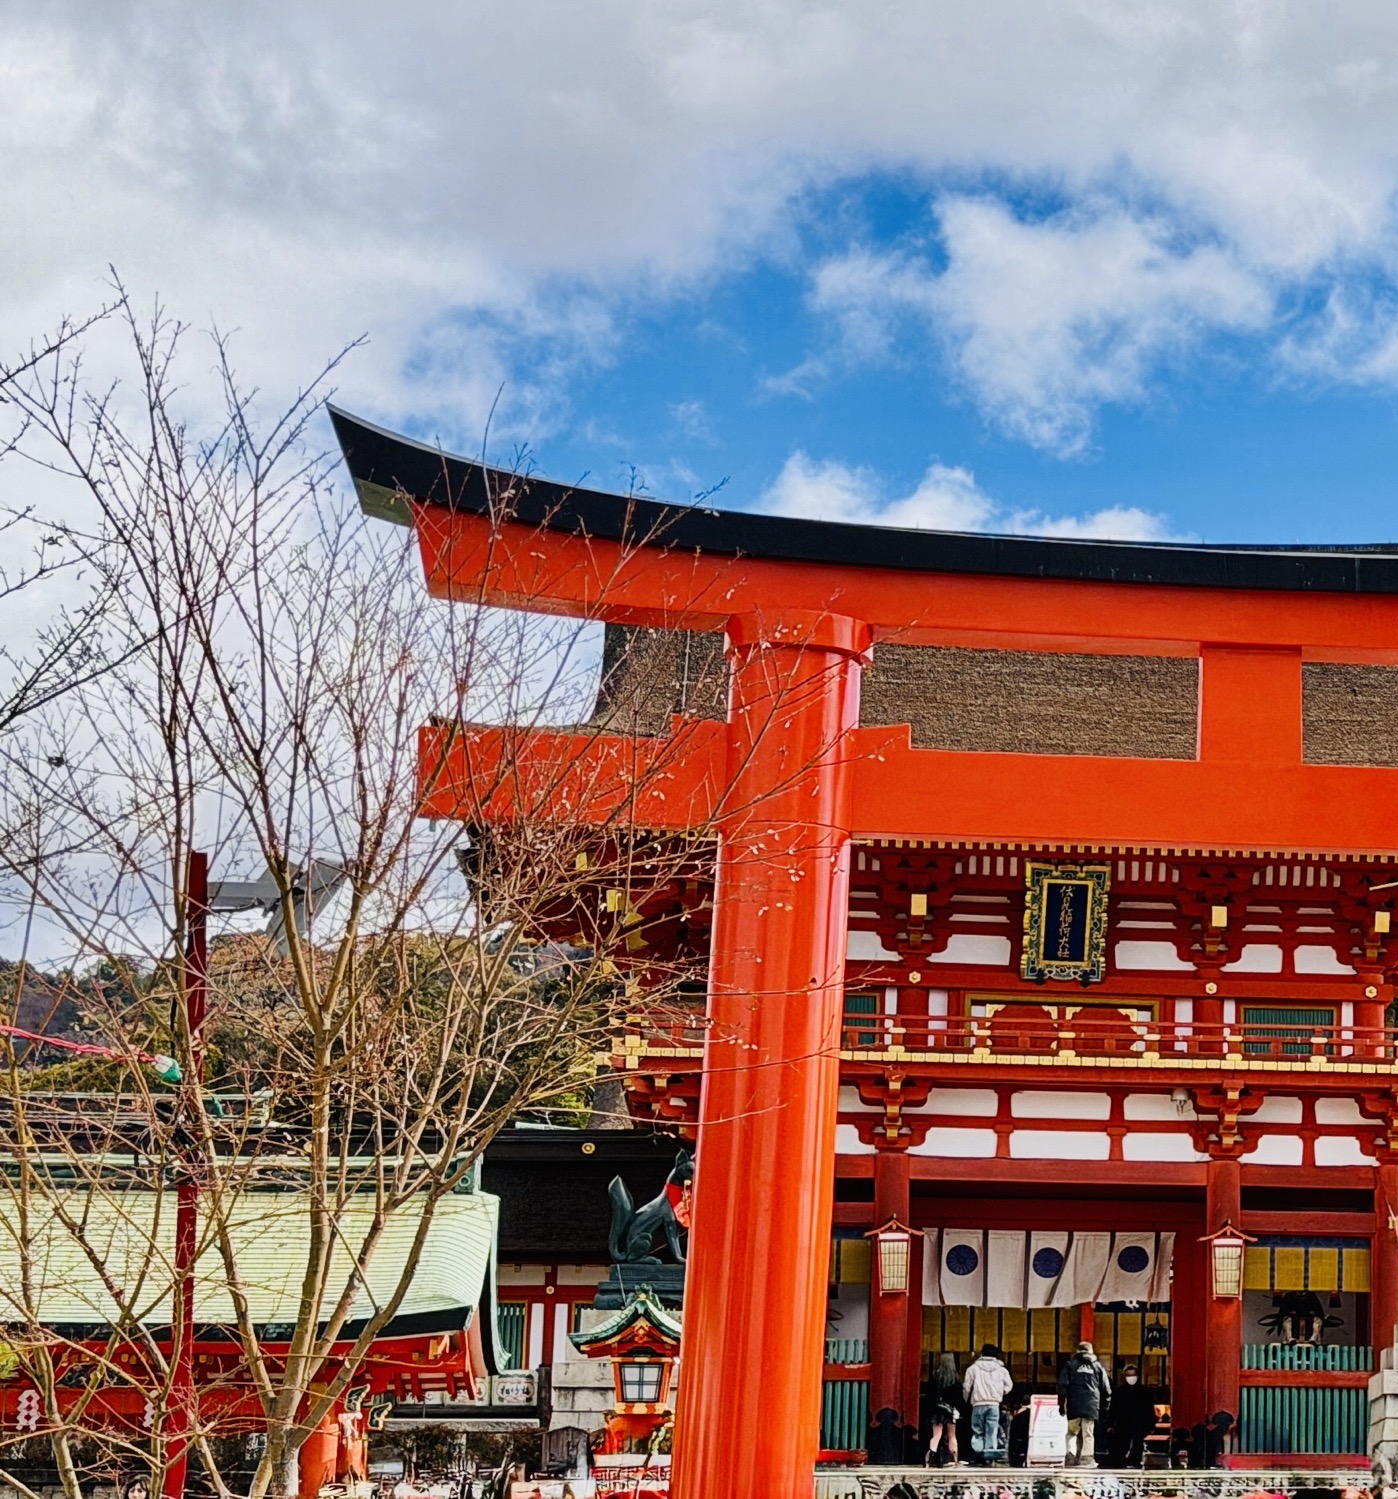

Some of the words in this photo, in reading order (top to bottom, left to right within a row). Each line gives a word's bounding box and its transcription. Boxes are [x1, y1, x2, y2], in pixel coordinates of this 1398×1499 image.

[1057, 885, 1075, 958] 伏見稲荷大社
